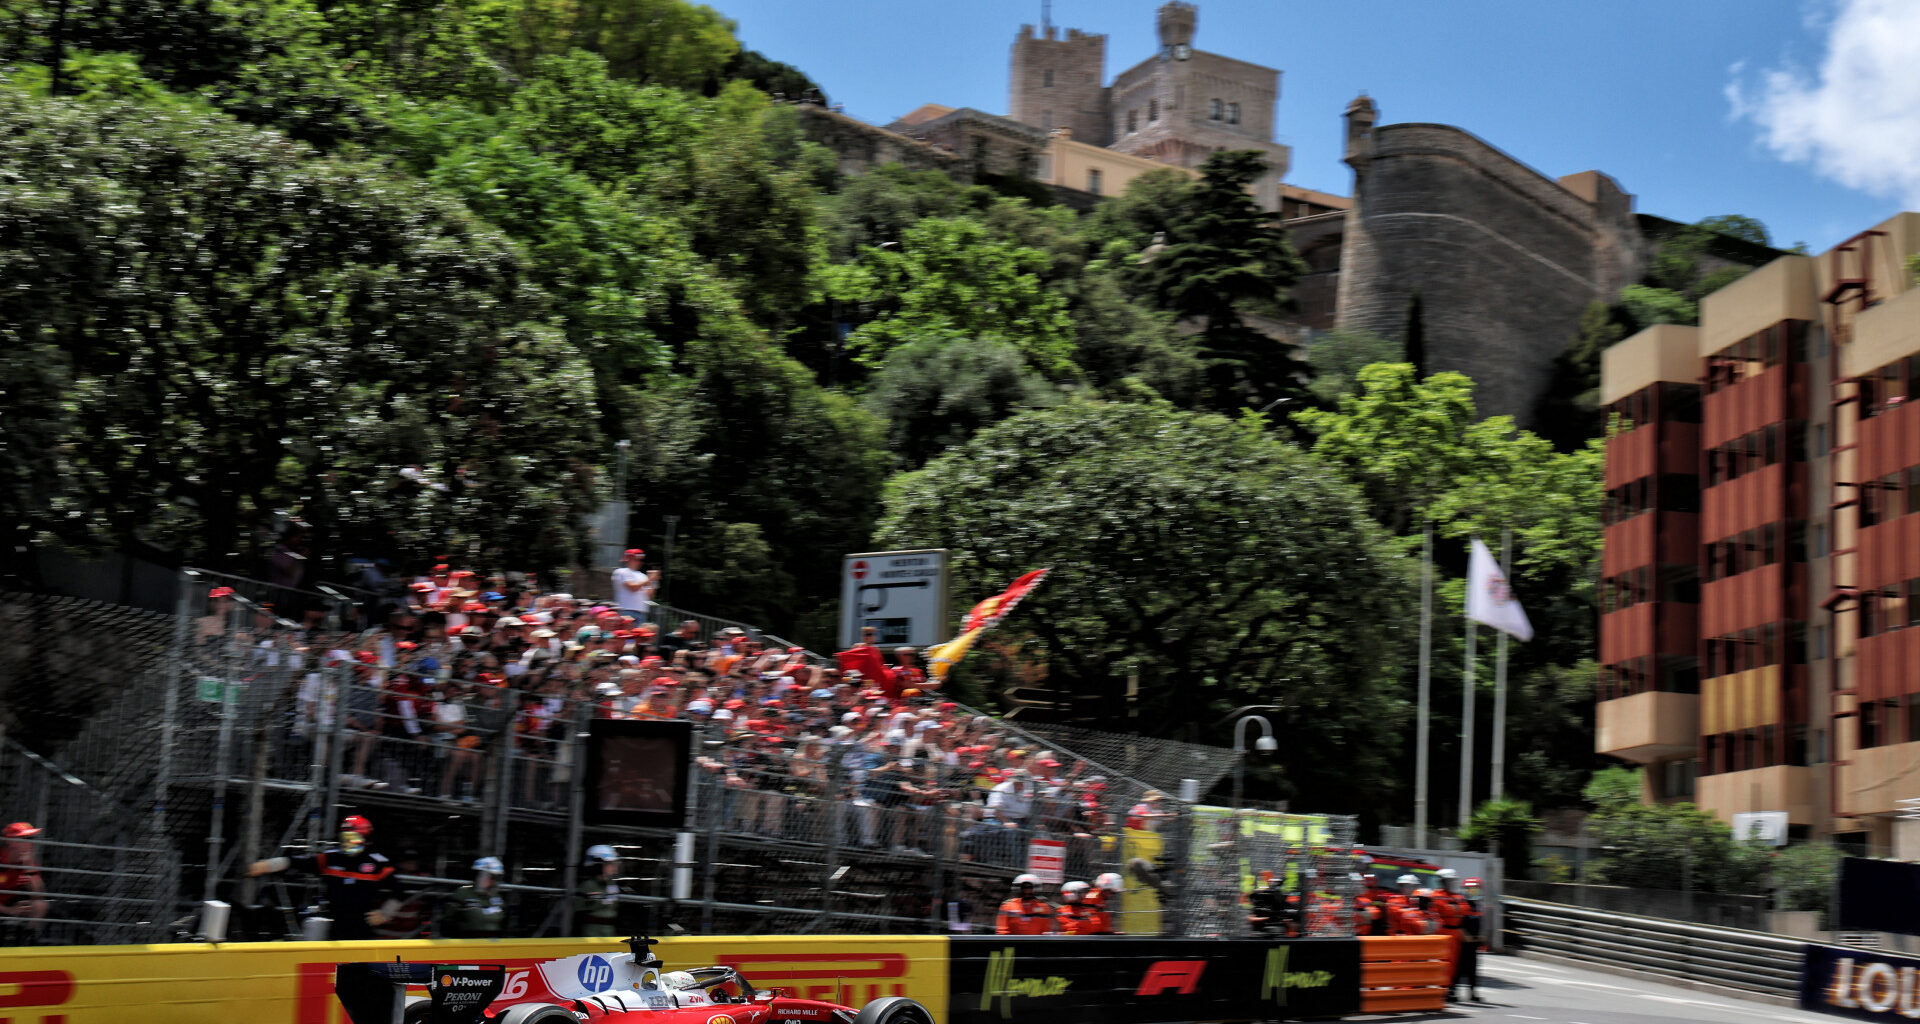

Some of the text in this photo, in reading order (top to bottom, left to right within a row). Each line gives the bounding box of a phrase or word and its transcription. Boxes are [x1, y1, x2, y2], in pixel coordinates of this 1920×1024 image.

[583, 954, 609, 993] hp
[1134, 960, 1208, 995] F1
[452, 976, 493, 987] V-Power
[496, 971, 530, 1001] 16
[444, 992, 483, 1002] PERONI
[648, 995, 676, 1007] IBM
[688, 995, 704, 1003] ZYN
